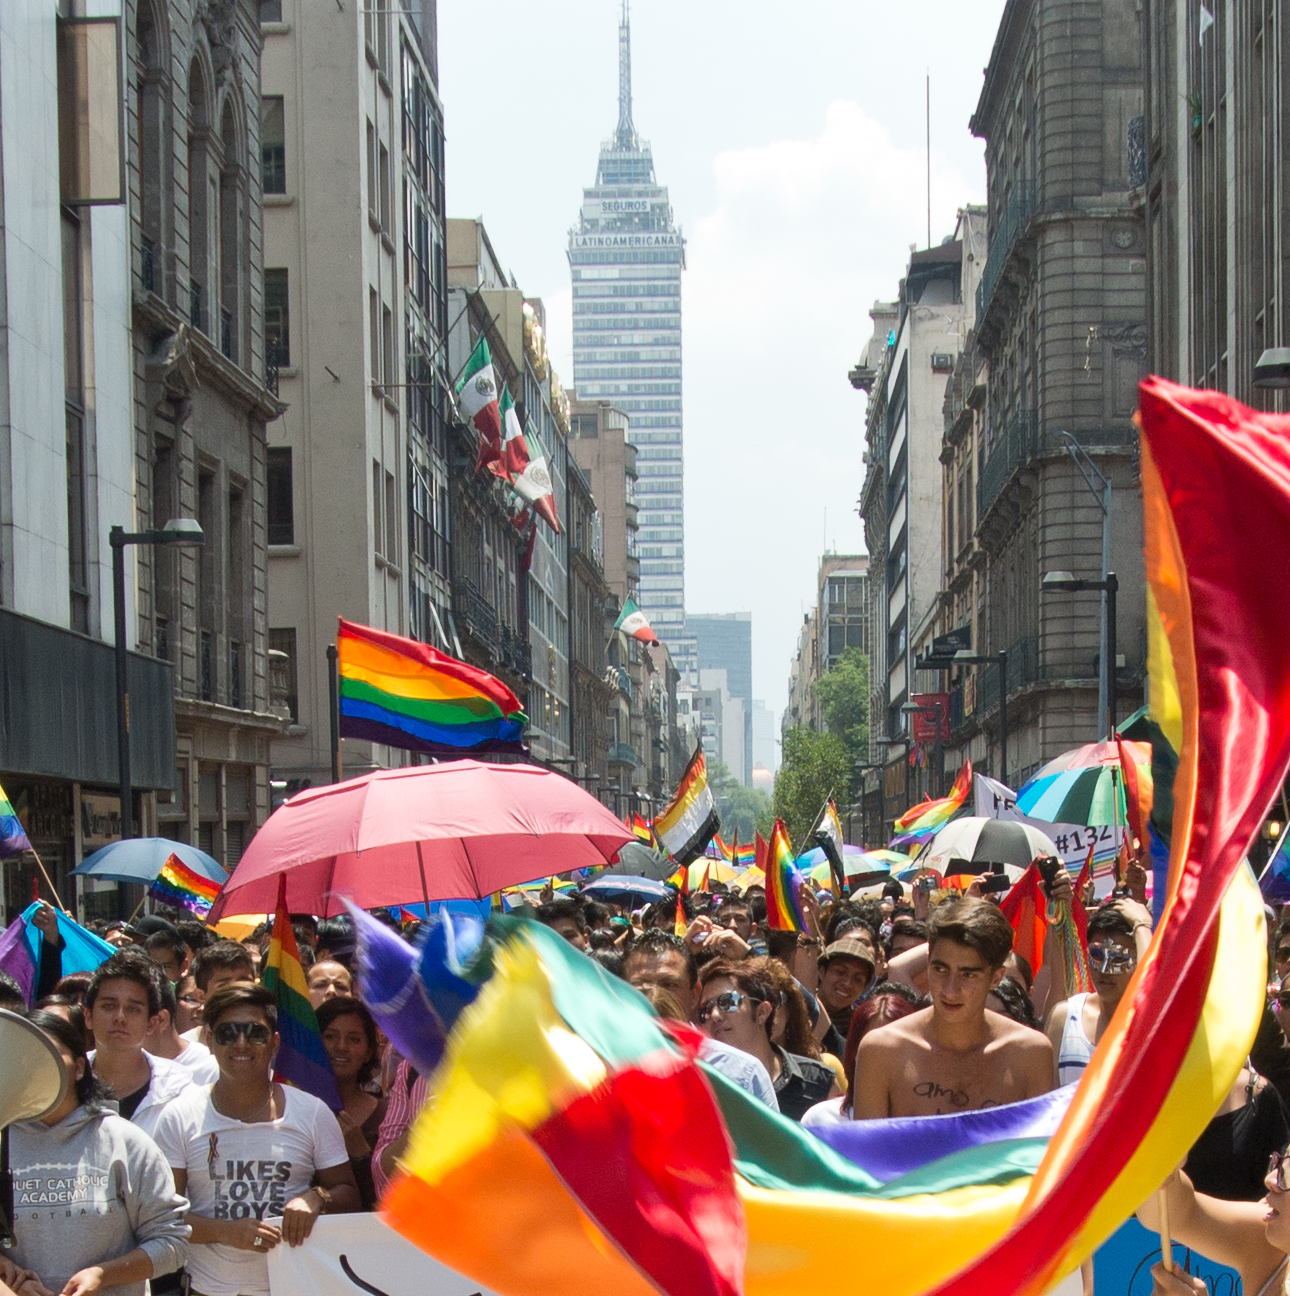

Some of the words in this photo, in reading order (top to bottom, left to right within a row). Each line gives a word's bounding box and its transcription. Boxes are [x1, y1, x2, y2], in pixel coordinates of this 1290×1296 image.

[602, 201, 647, 212] SEGUROS
[575, 235, 675, 247] LATINOAMERICANA
[913, 1082, 970, 1108] amo
[209, 1160, 292, 1181] LIKES
[20, 1187, 88, 1203] ACADEMY
[213, 1181, 285, 1202] LOVE
[213, 1201, 285, 1221] BOYS
